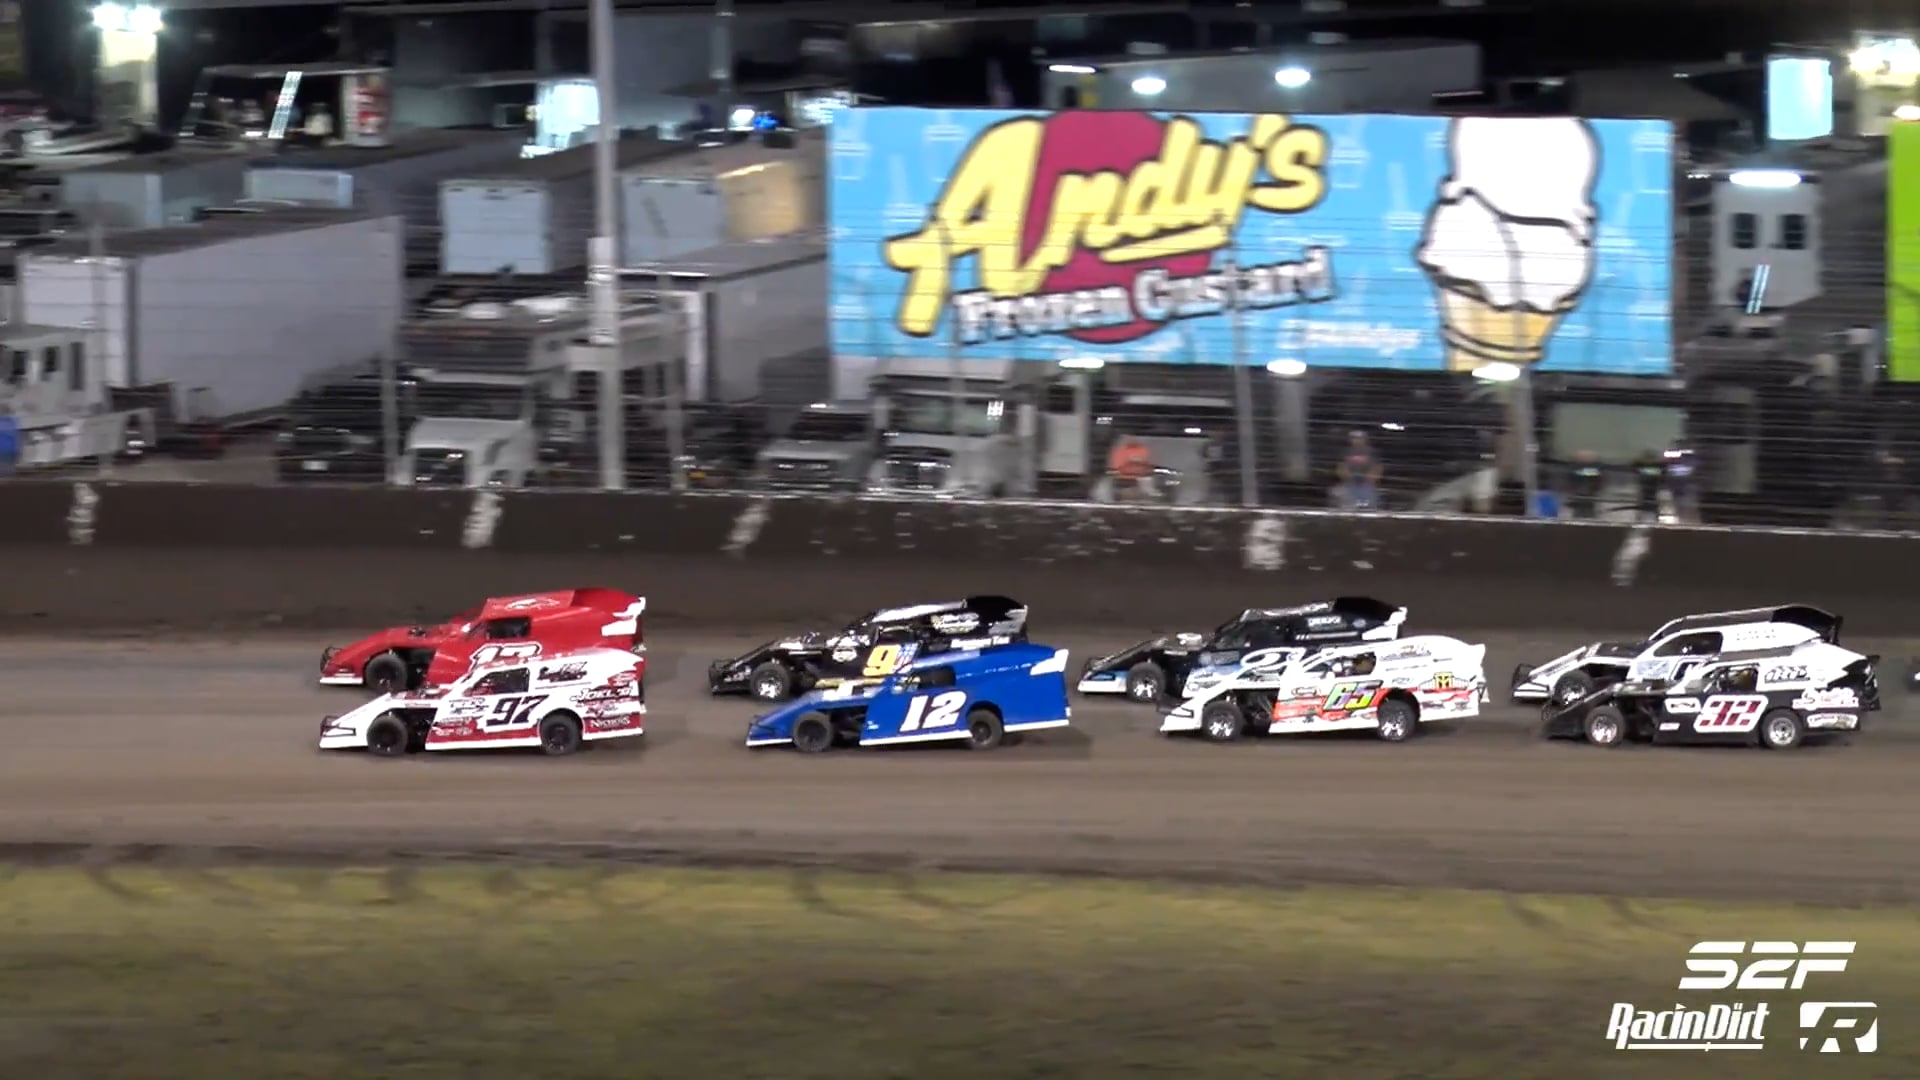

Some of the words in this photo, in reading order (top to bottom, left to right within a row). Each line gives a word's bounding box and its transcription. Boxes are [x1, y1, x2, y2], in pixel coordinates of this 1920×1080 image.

[882, 113, 1330, 336] Andy's
[952, 285, 1134, 345] Frozen
[1132, 246, 1335, 321] Custard
[485, 693, 550, 727] 97
[899, 690, 967, 733] 12
[1322, 680, 1384, 711] 65
[1698, 699, 1762, 727] 32
